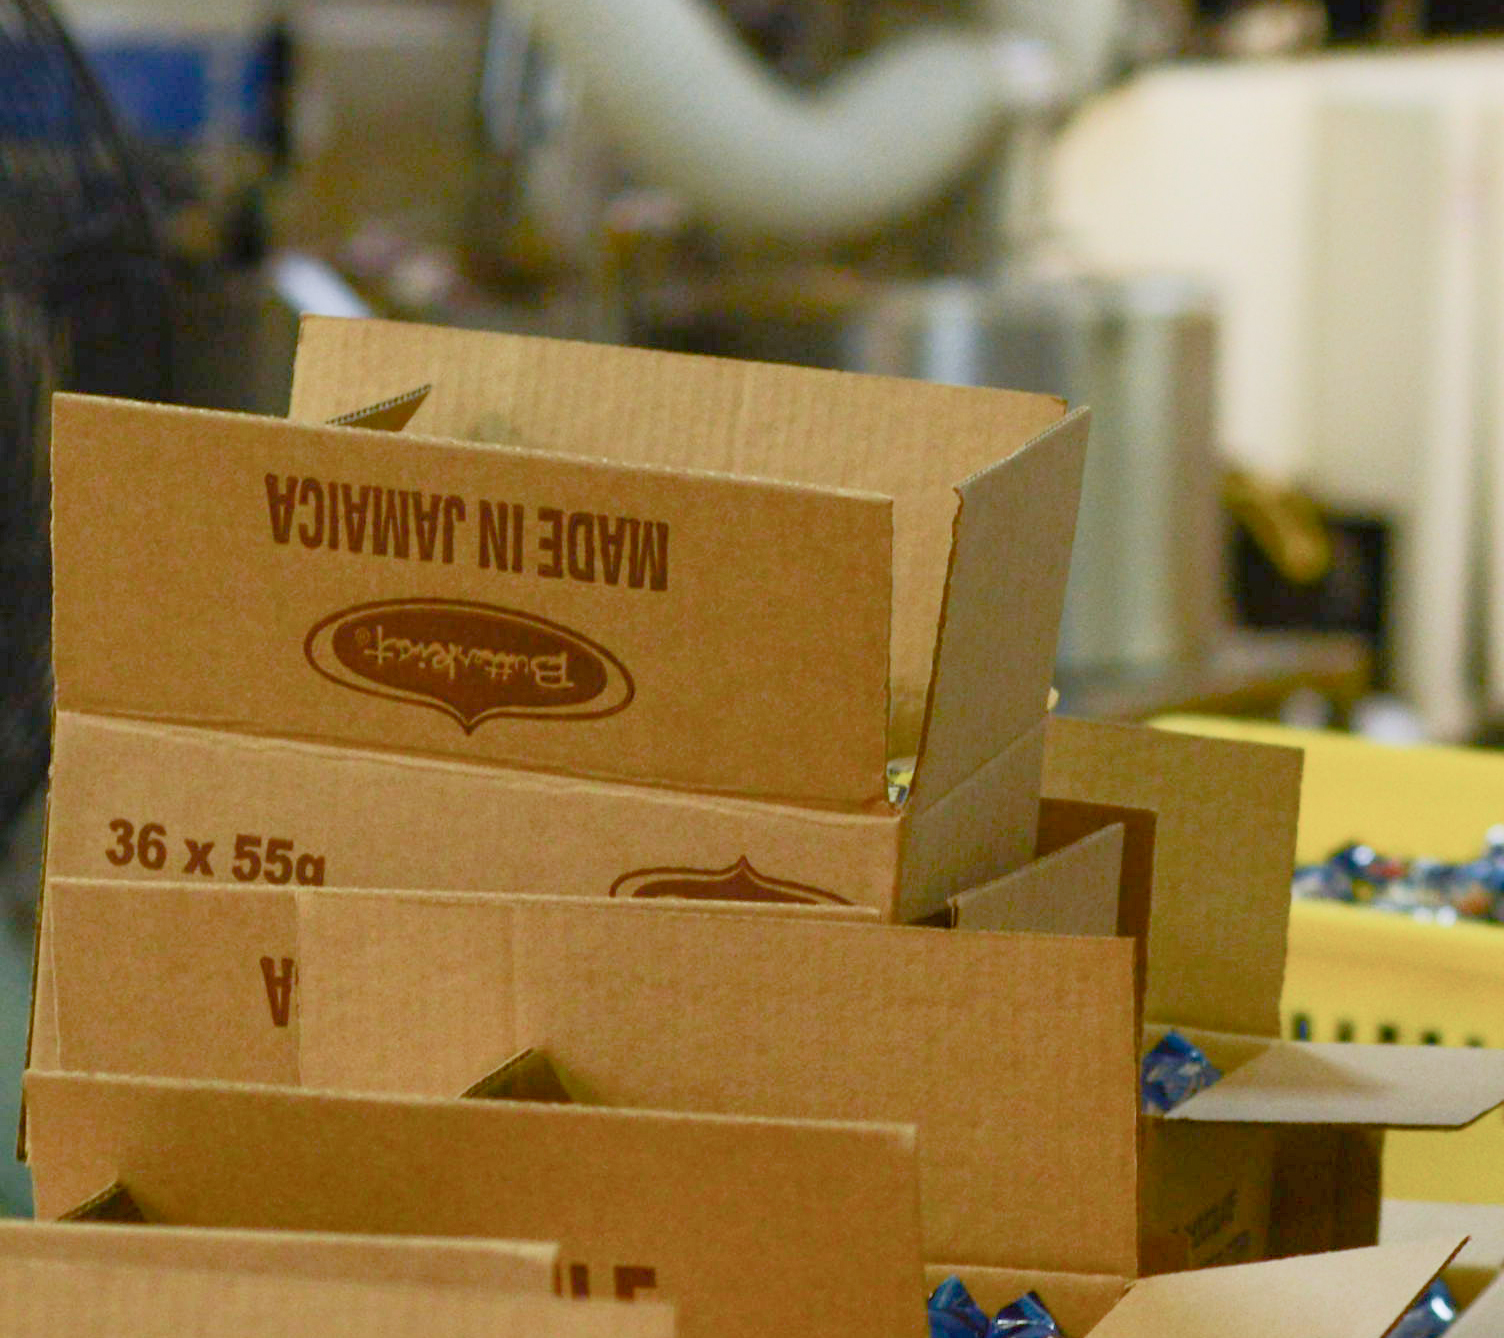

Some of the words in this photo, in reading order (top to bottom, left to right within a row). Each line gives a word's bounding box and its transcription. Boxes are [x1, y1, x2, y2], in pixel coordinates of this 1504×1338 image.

[264, 472, 466, 564] JAMAICA
[478, 499, 524, 573] IN
[537, 506, 669, 591] MADE
[105, 818, 167, 871] 36
[182, 838, 215, 877] x
